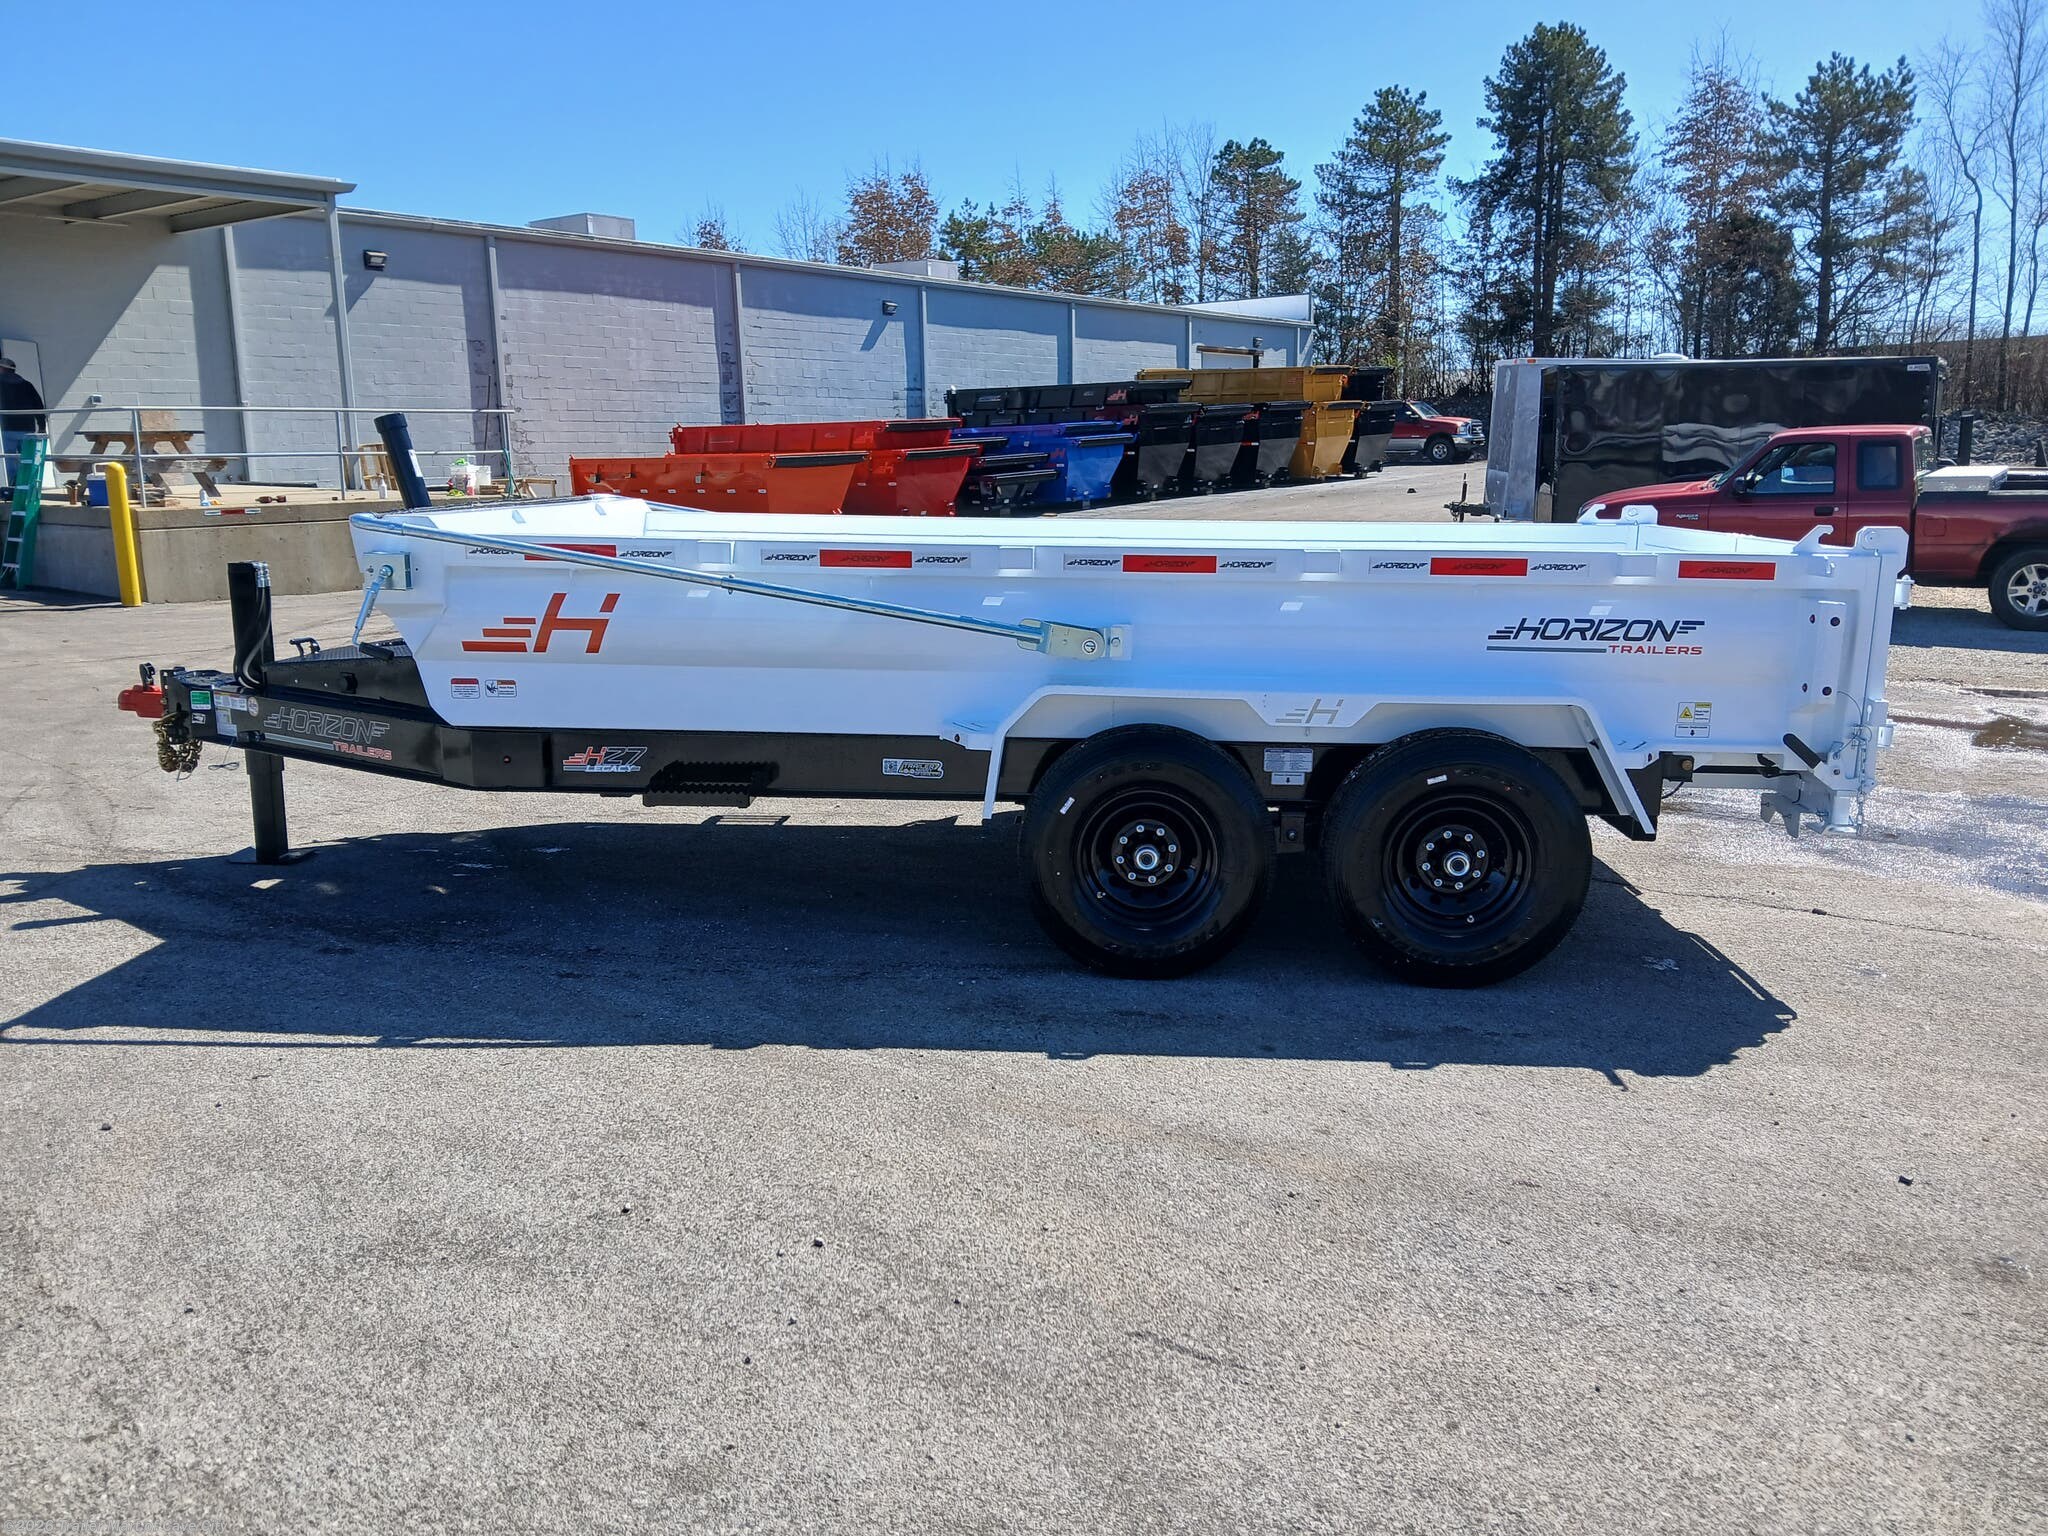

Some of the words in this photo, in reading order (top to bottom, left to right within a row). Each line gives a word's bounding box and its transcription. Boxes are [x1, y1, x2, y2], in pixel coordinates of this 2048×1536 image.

[472, 547, 515, 555] HORIZO
[769, 553, 812, 561] HORIZON
[845, 555, 887, 563] HORIZON
[919, 556, 963, 564] HORIZON
[1072, 558, 1115, 567] HORIZON
[1148, 560, 1191, 568] HORIZON
[1224, 560, 1268, 569] HORIZON
[1378, 562, 1423, 570] HORIZON
[533, 592, 621, 654] H
[1511, 617, 1682, 642] HORIZON
[1608, 644, 1703, 656] TRAILERS
[276, 705, 380, 744] HORIZON
[332, 740, 393, 761] TRAILERS
[583, 746, 648, 767] H27
[584, 765, 635, 773] LEGACY
